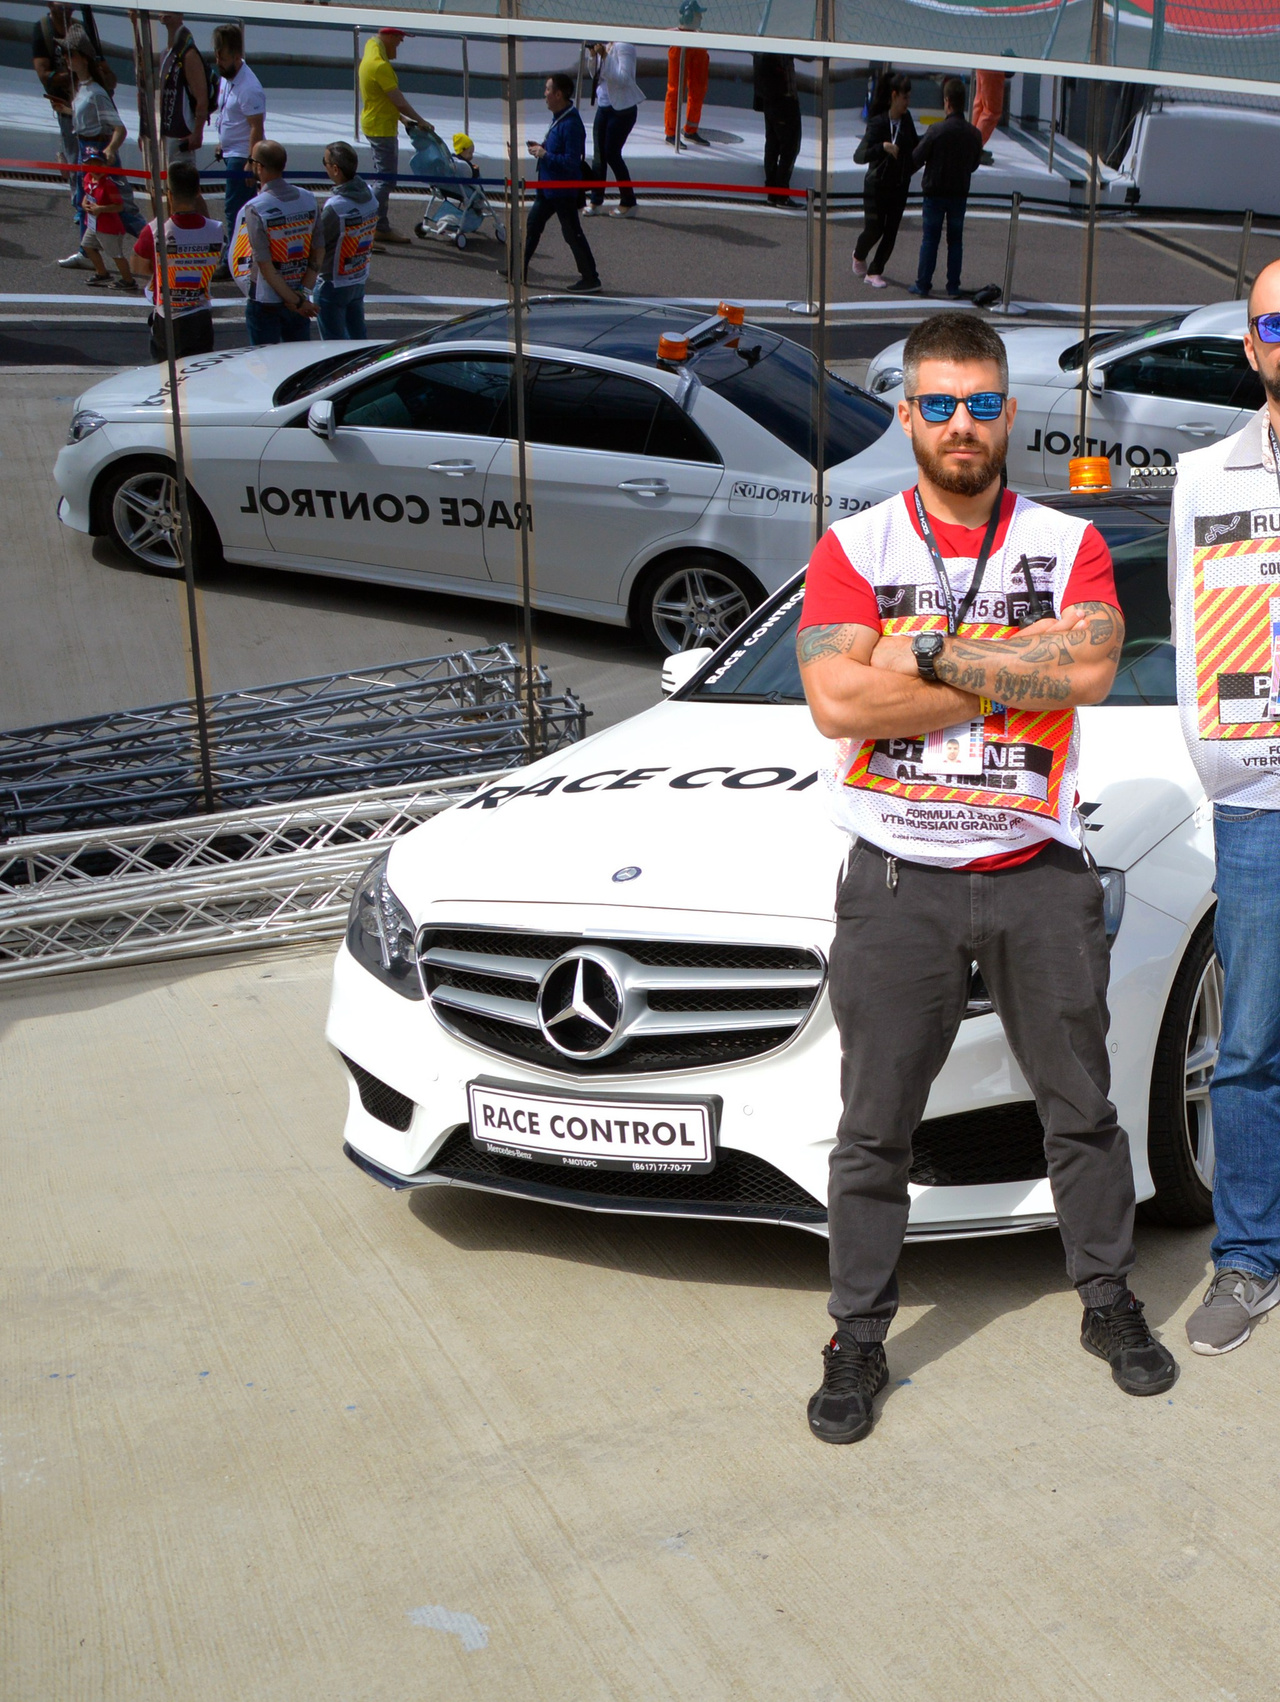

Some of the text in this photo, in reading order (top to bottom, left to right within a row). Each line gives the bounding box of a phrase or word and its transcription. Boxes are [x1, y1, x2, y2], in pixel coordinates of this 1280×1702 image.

[918, 590, 1006, 618] RU158
[704, 650, 746, 684] RACE
[983, 744, 1026, 767] NE
[1242, 757, 1268, 767] VTB
[456, 767, 673, 809] RACE
[881, 813, 905, 826] VTB
[906, 819, 959, 831] RUSSIAN
[960, 821, 1008, 831] GRAND
[905, 808, 1007, 823] FORMULA 1 2018
[482, 1103, 696, 1146] RACE CONTROL
[486, 1142, 533, 1160] Mercedes-Benz
[632, 1161, 692, 1172] (8617) 77-70-77
